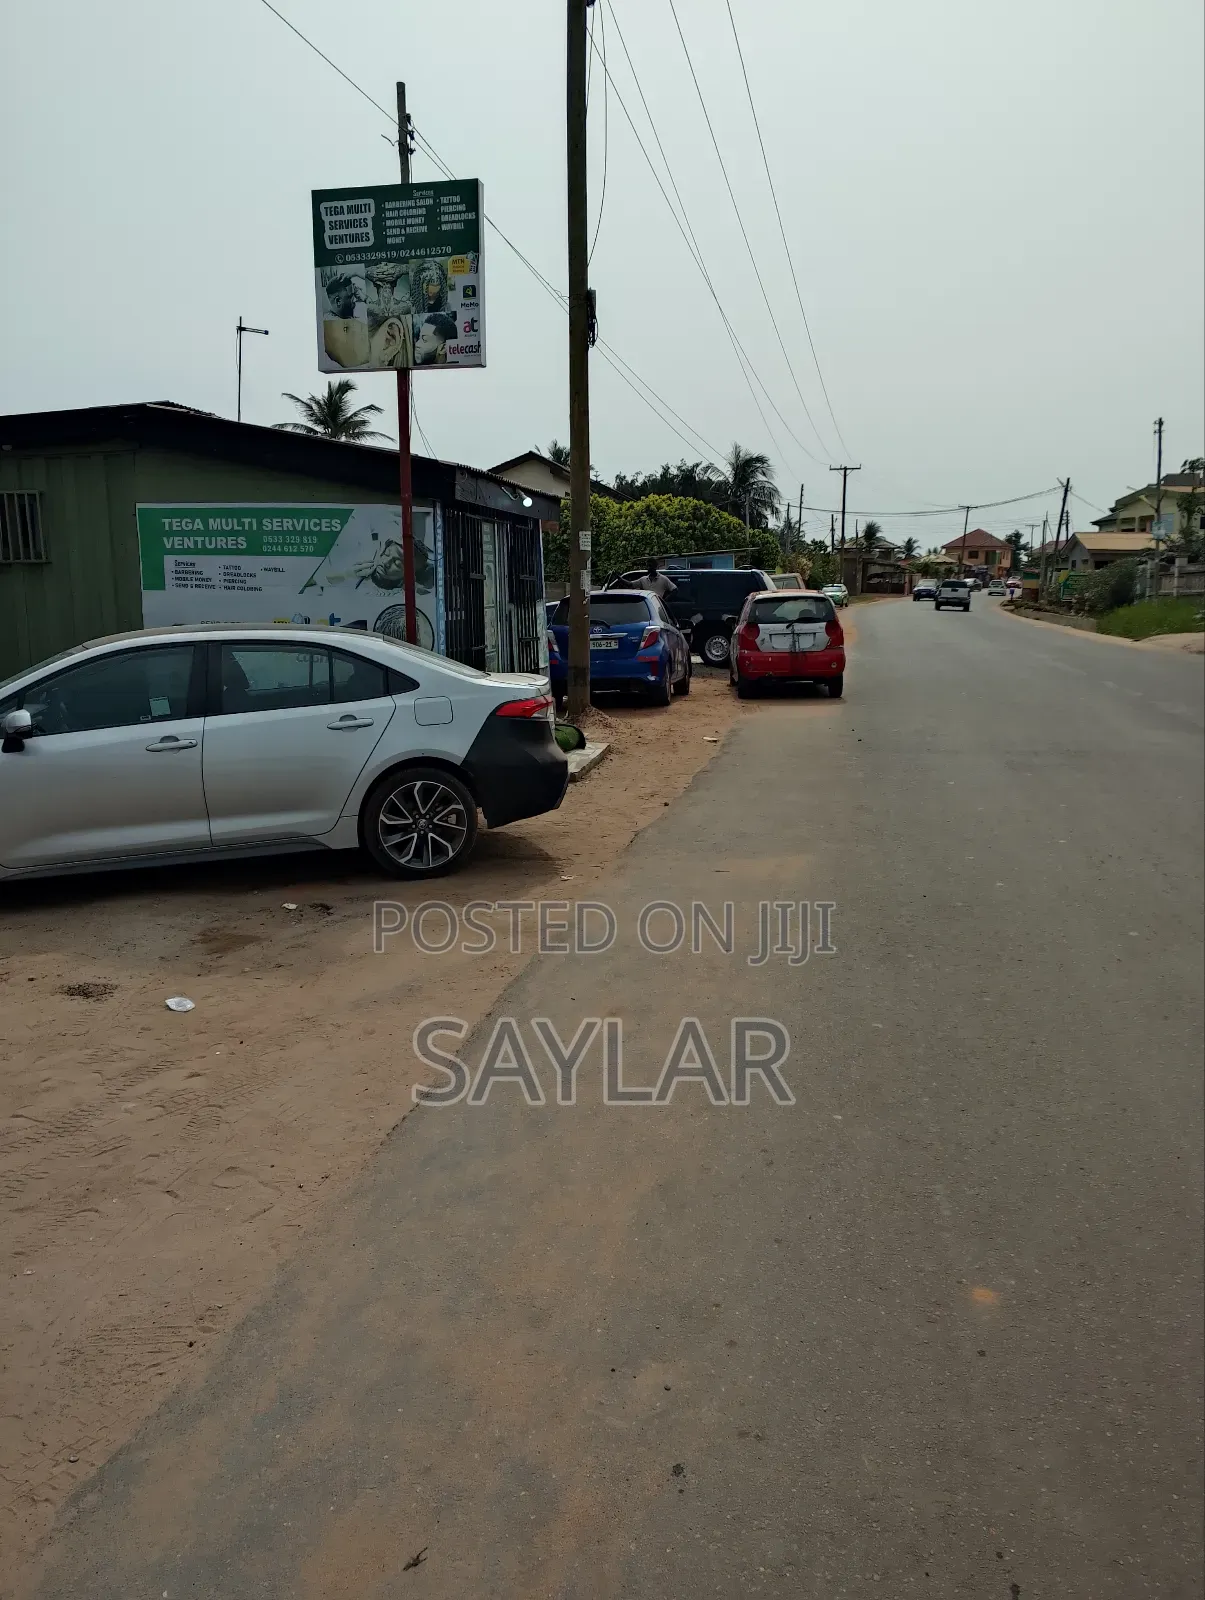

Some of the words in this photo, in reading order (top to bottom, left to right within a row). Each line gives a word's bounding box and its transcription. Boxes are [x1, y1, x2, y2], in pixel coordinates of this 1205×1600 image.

[385, 200, 415, 209] BARBERING
[416, 198, 434, 206] SALON
[440, 195, 460, 204] TATTOO
[324, 205, 345, 216] TEGA
[346, 203, 371, 214] MULTI
[441, 204, 466, 212] PIERCING
[386, 210, 398, 218] HAIR
[400, 208, 426, 217] COLORING
[441, 212, 476, 221] DREADLOCKS
[329, 218, 368, 231] SERVICES
[386, 218, 406, 226] MOBILE
[407, 217, 424, 225] MONEY
[406, 225, 428, 234] RECEIVE
[442, 222, 464, 231] WAYBILL
[328, 232, 370, 245] VENTURES
[387, 236, 405, 245] MONEY
[162, 518, 204, 530] TEGA
[208, 518, 256, 530] MULTI
[262, 518, 341, 532] SERVICES
[163, 536, 247, 549] VENTURES
